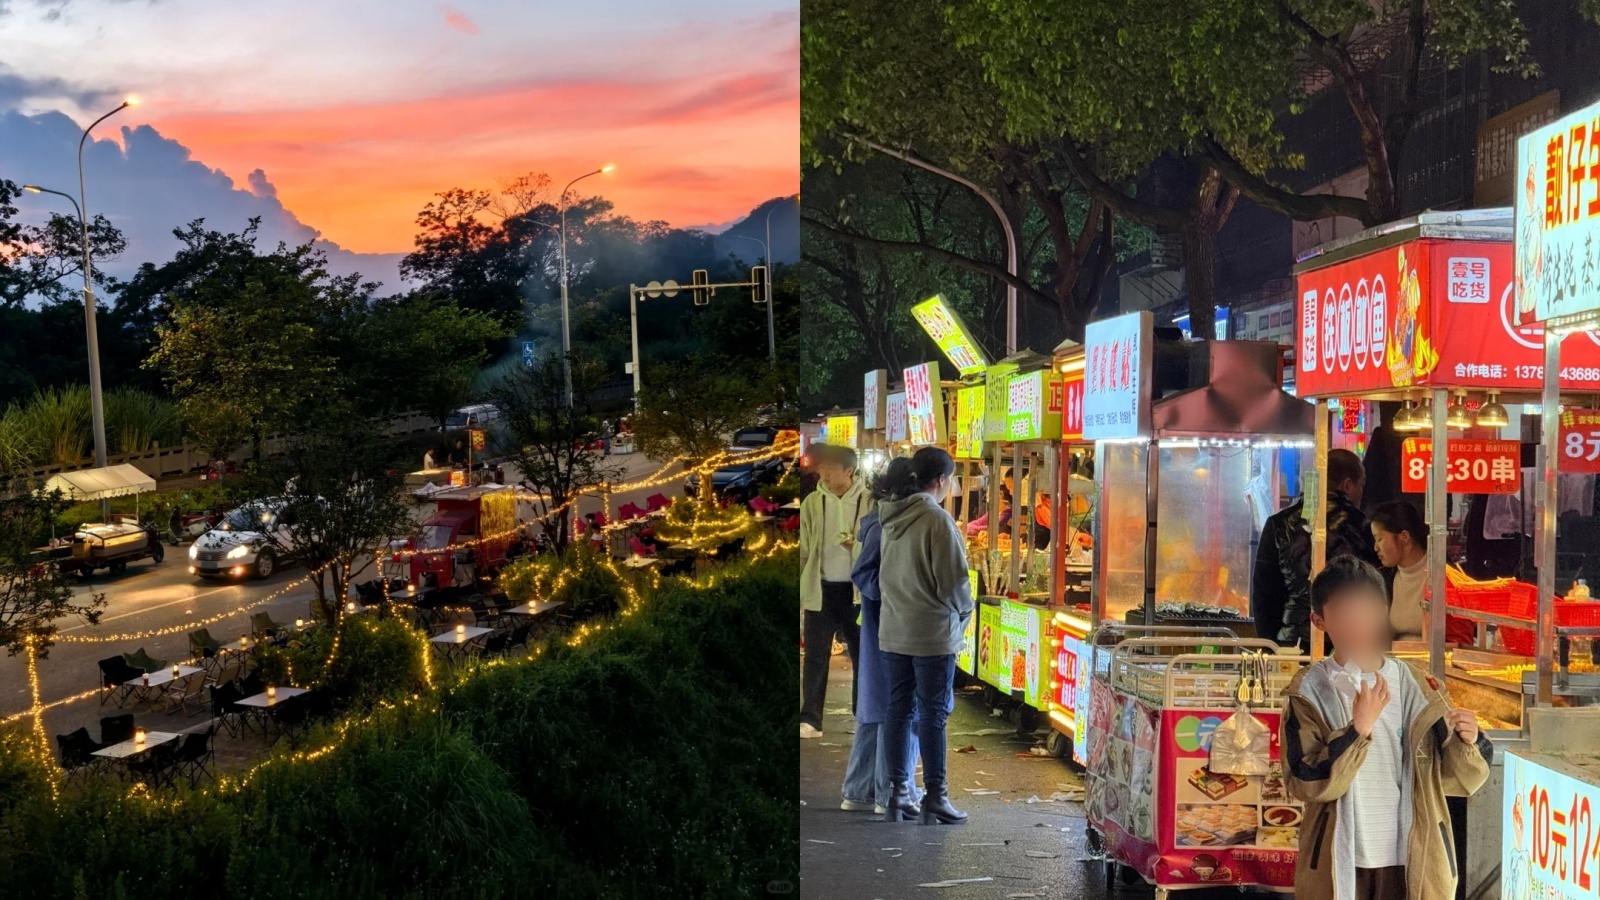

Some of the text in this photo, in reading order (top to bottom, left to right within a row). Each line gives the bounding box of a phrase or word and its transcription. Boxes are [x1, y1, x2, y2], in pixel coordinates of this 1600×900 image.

[1452, 261, 1486, 279] 壹号
[1452, 282, 1486, 298] 吃货
[1324, 290, 1385, 361] 铁板鱿鱼
